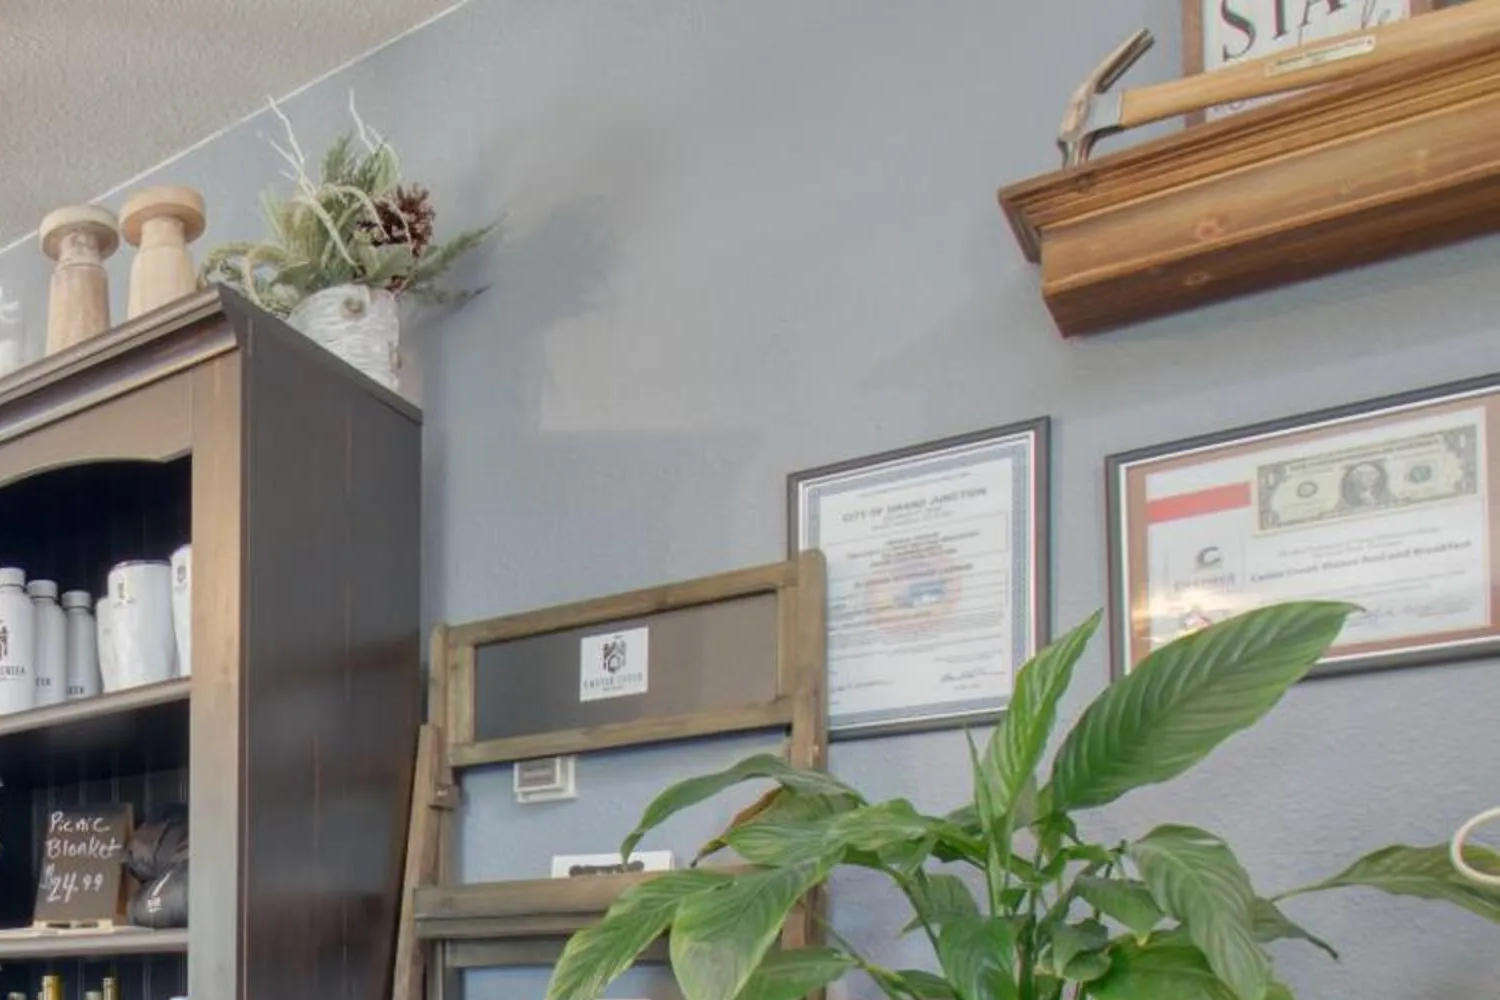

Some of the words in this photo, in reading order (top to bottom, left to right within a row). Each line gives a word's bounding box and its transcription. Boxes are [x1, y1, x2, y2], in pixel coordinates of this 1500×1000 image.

[50, 811, 110, 833] Picnic
[46, 835, 122, 859] Blanket
[40, 863, 104, 903] $24.99
